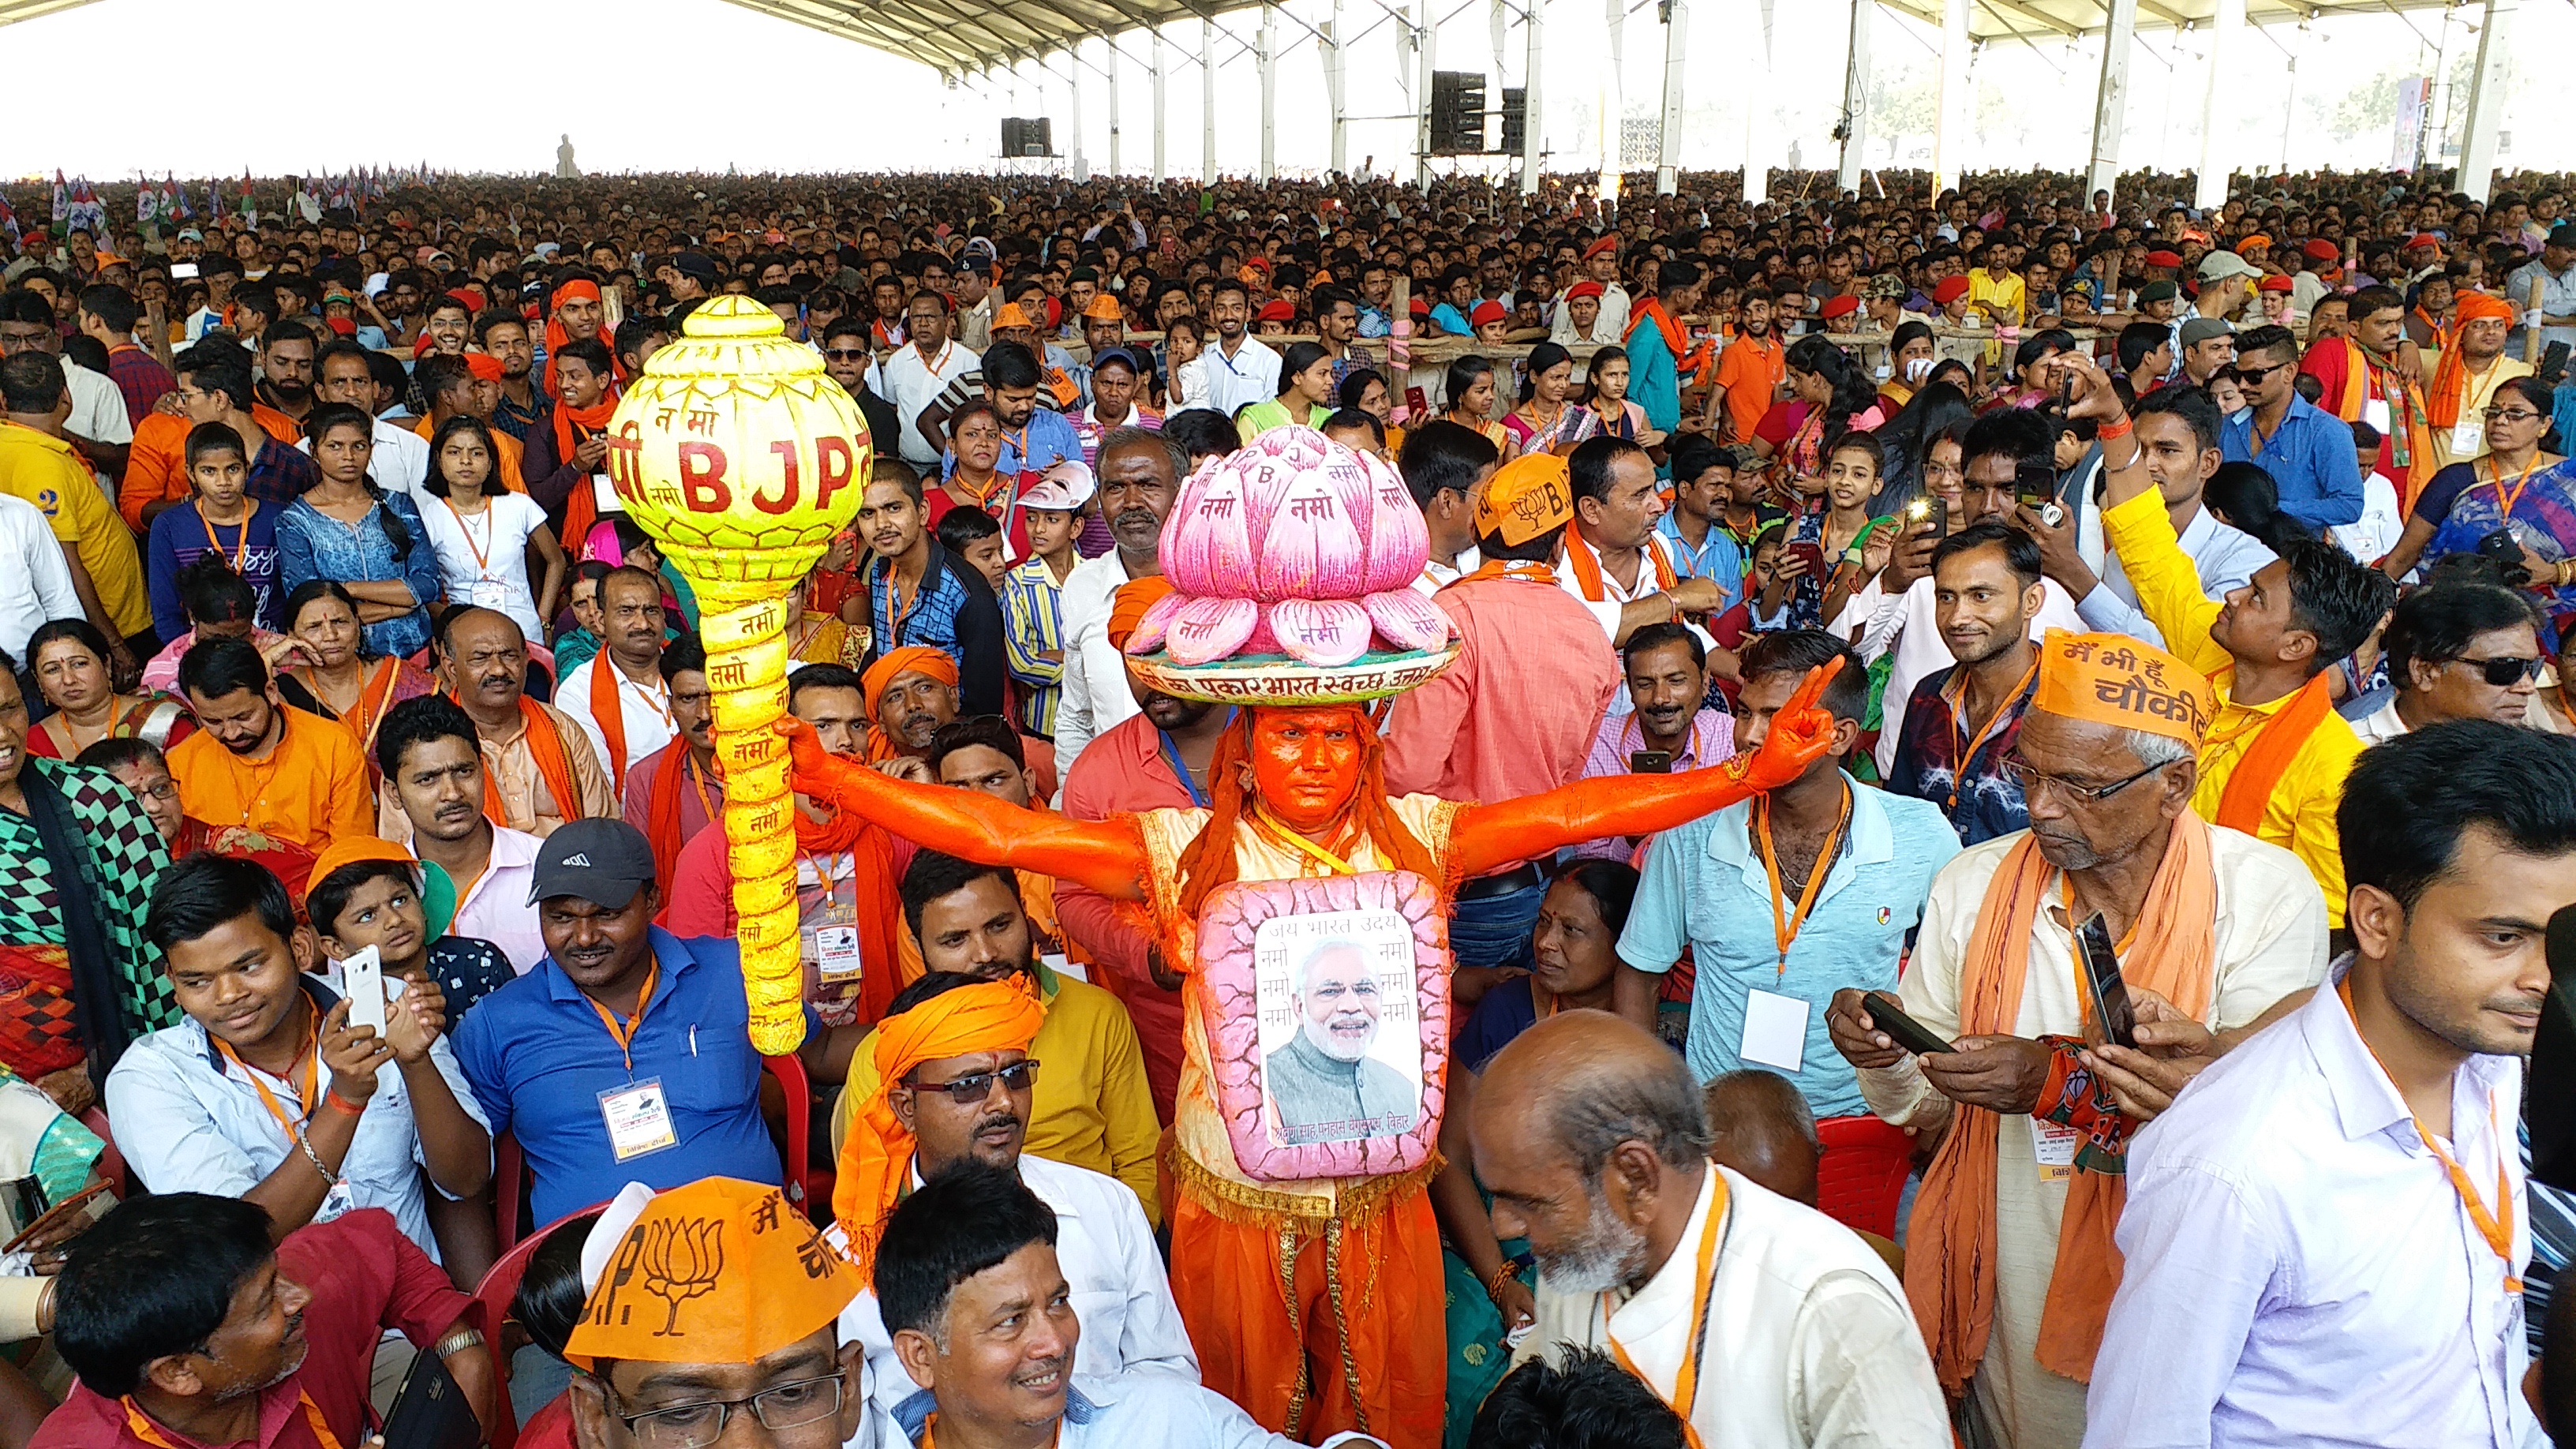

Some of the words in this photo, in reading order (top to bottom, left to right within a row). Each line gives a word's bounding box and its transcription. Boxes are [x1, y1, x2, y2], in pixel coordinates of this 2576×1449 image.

[1200, 489, 1237, 522] नमो
[1290, 488, 1335, 524] नमो
[1378, 478, 1410, 511] नमो
[738, 605, 777, 635] नमो
[2063, 642, 2099, 663] मैं
[2100, 647, 2139, 672] भी
[710, 655, 750, 688] नमो
[733, 732, 773, 763] नमो
[751, 807, 781, 833] नमो
[739, 922, 765, 943] नमो
[1268, 922, 1298, 938] जय
[1307, 918, 1352, 935] भारत
[1360, 914, 1398, 931] उदय
[1260, 942, 1288, 968] नमो
[1378, 934, 1406, 961] नमो
[1262, 971, 1290, 998] नमो
[1380, 964, 1409, 991] नमो
[1264, 1001, 1293, 1028] नमो
[1381, 994, 1410, 1022] नमो
